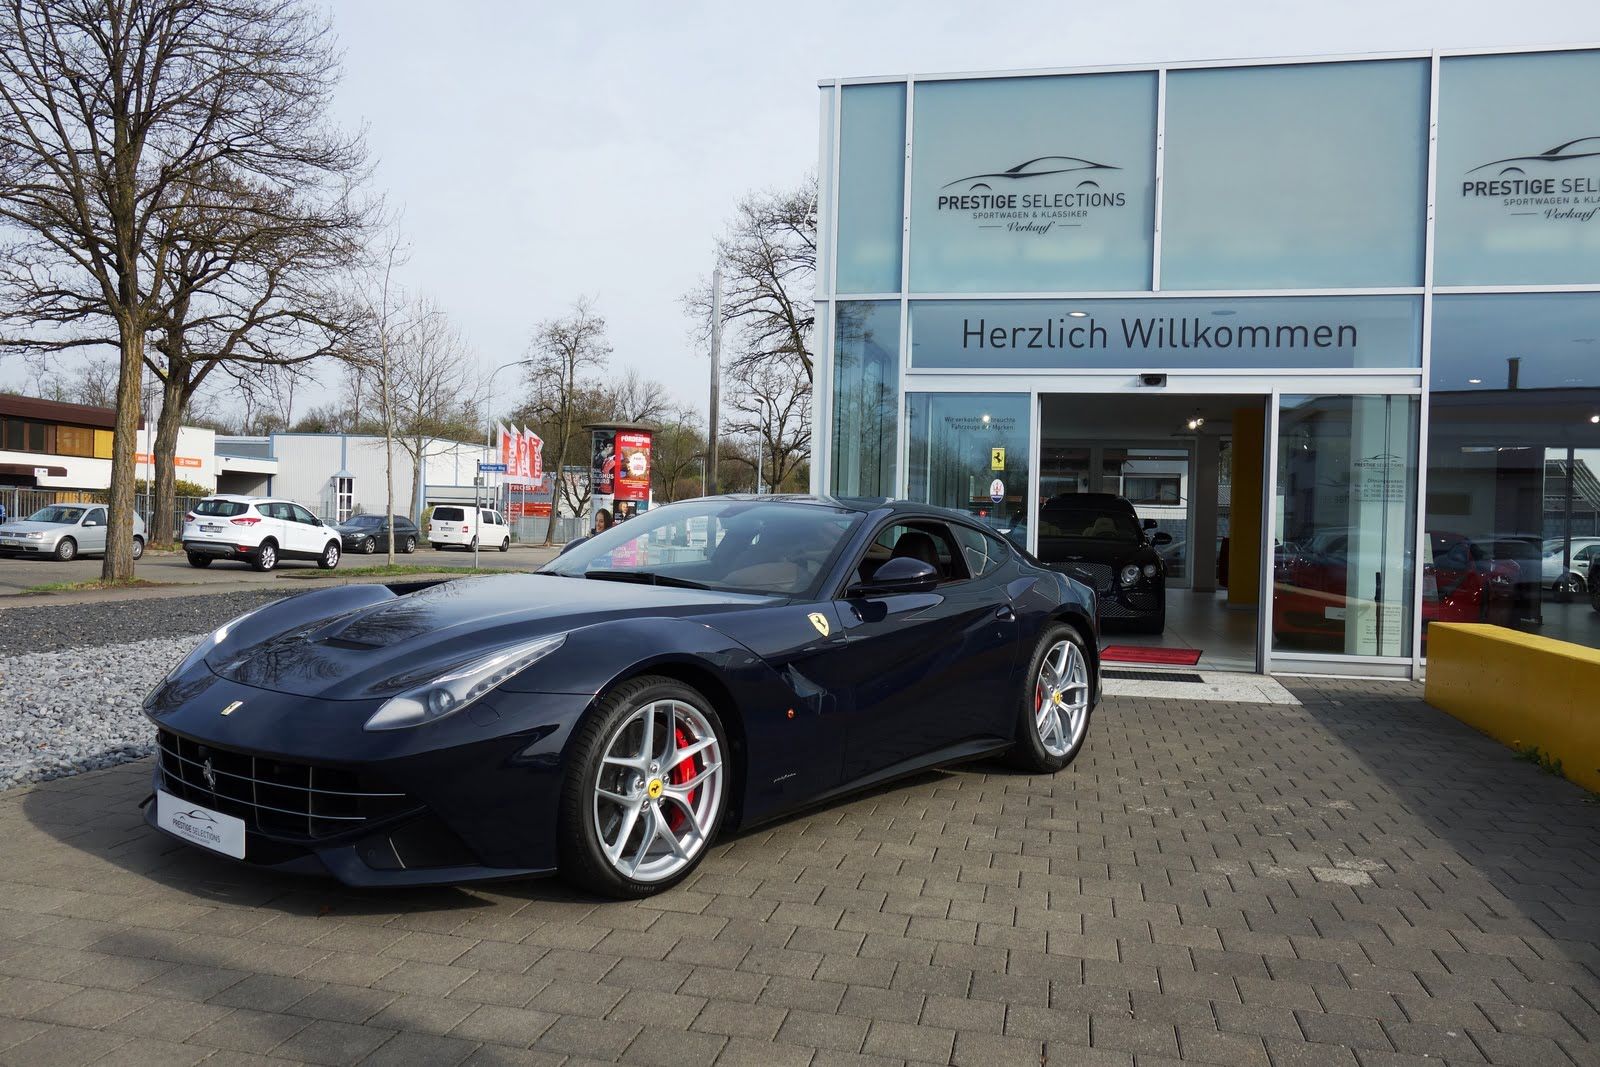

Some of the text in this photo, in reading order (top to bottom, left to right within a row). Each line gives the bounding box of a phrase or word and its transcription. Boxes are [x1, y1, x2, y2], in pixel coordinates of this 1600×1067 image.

[1462, 178, 1600, 197] PRESTIGE SEL
[937, 192, 1126, 210] PRESTIGE SELECTIONS
[1503, 197, 1570, 206] SPORTWAGEN
[1573, 196, 1580, 204] &
[972, 210, 1088, 220] SPORTWAGEN & KLASSIKER
[1543, 207, 1600, 222] Verkauf
[1006, 220, 1056, 234] Verkauf
[962, 316, 1358, 349] Herzlich Willkommen
[172, 818, 192, 834] PRESTIGE
[192, 825, 221, 844] SELECTIONS
